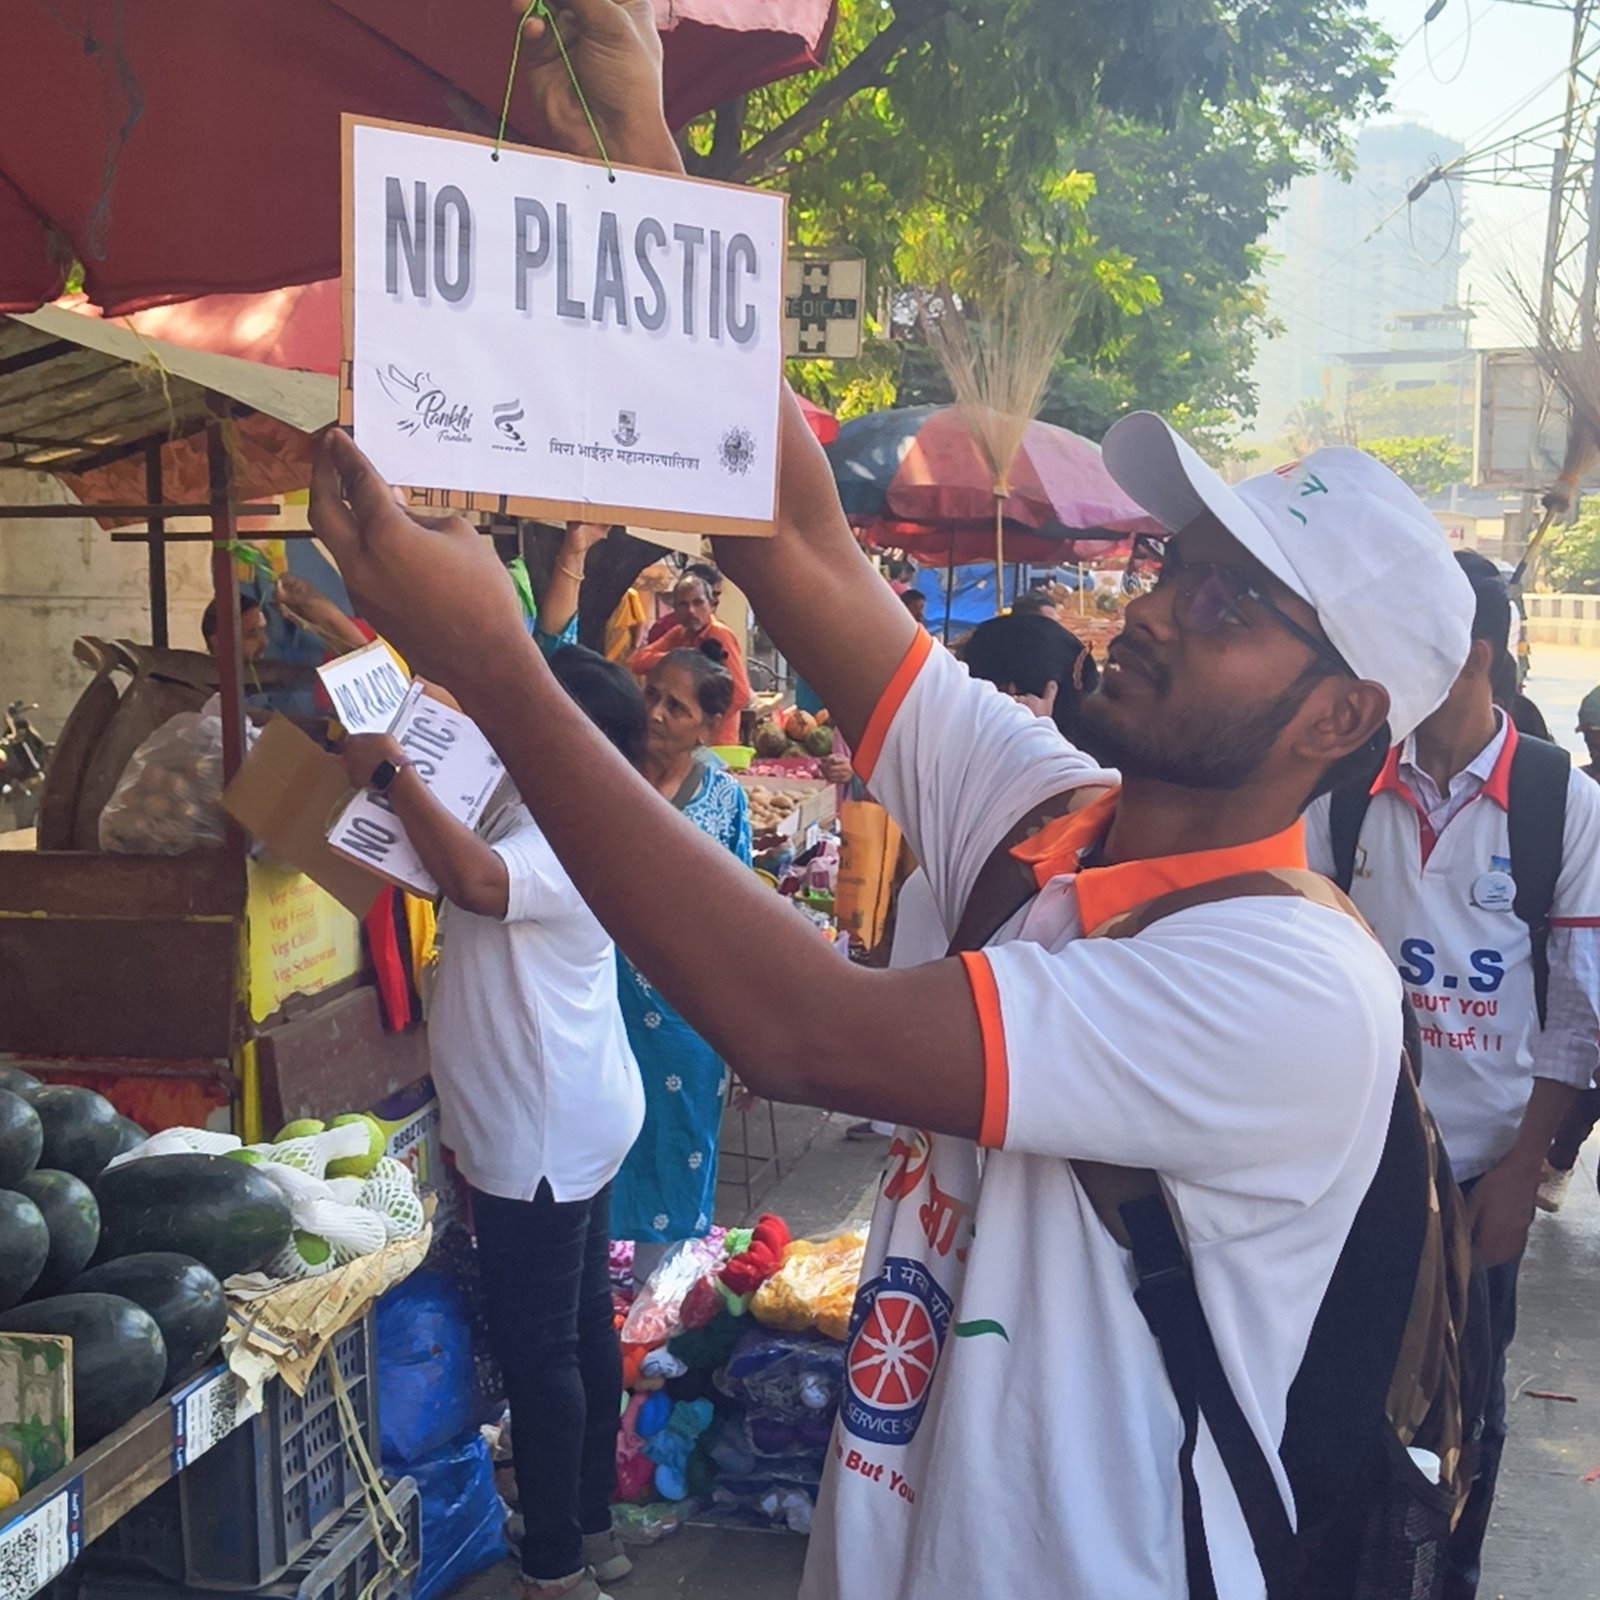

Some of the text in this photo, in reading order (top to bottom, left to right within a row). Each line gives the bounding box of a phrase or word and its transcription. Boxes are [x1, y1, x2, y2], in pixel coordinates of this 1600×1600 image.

[385, 176, 760, 346] NO PLASTIC
[416, 390, 473, 433] Pankhi
[549, 437, 575, 456] मिरा
[334, 684, 367, 728] NO
[340, 816, 397, 863] NO
[1411, 992, 1498, 1018] BUT YOU
[847, 1403, 900, 1435] SERVICE
[845, 1449, 916, 1504] But You
